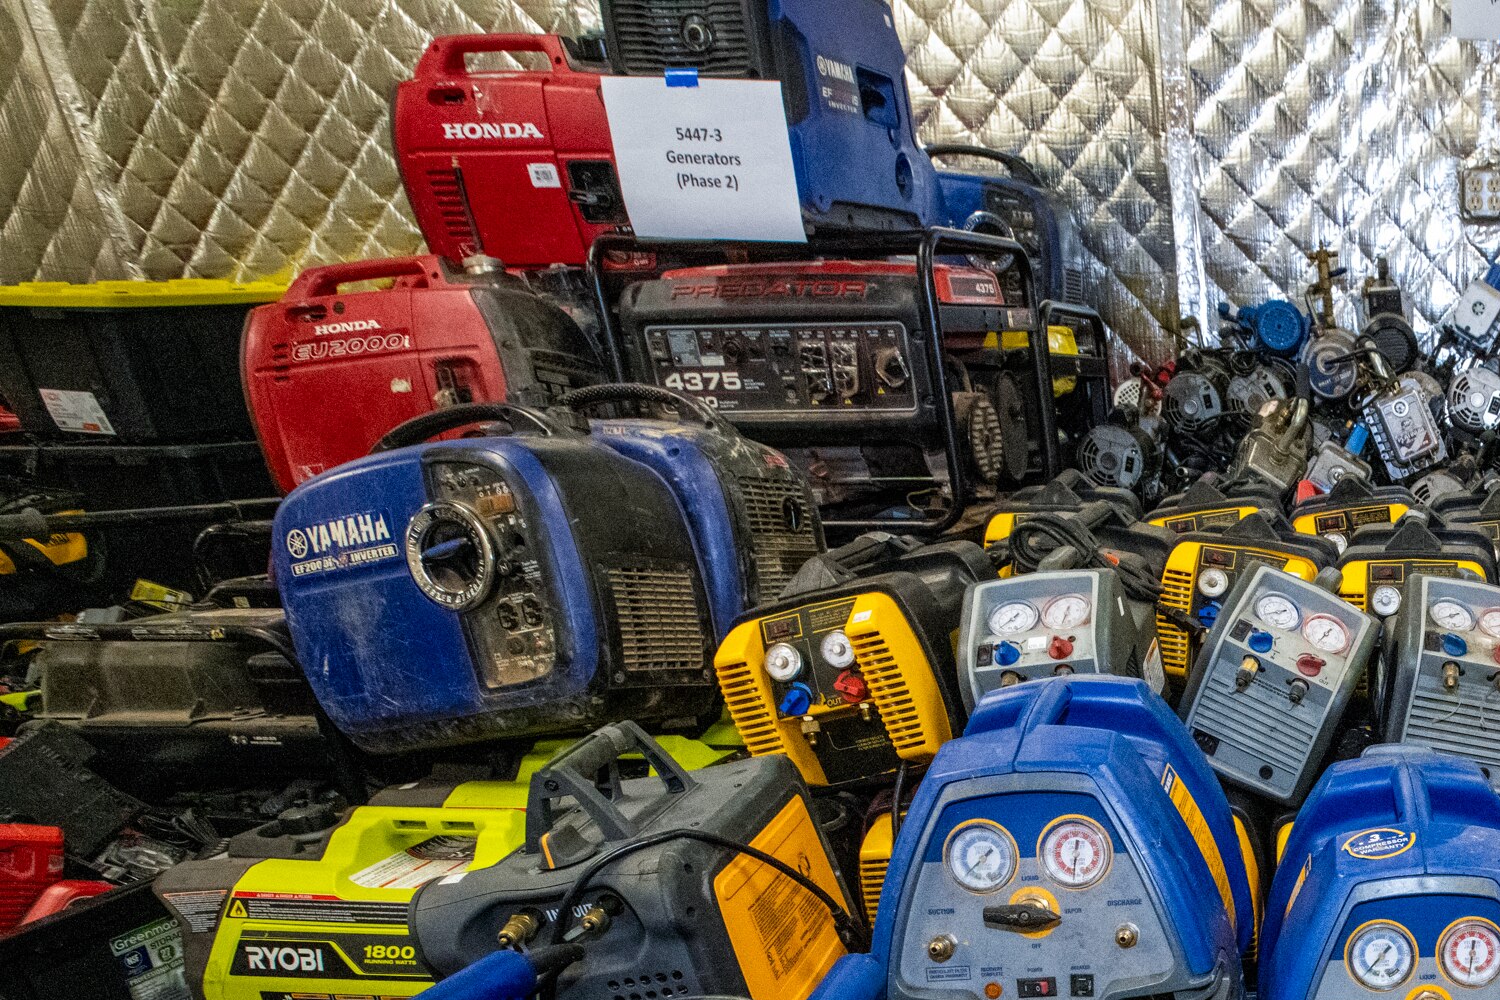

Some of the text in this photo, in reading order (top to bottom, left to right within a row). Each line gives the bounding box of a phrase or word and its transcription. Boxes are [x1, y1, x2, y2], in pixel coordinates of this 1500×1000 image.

[442, 122, 544, 139] HONDA
[676, 127, 723, 142] 5447-3
[666, 150, 742, 167] Generators
[677, 173, 740, 191] (Phase 2)
[671, 281, 867, 299] PREDATOR
[975, 284, 995, 294] 4375
[314, 319, 381, 336] HONDA
[292, 333, 411, 361] EU2000i
[665, 371, 742, 391] 4375
[306, 512, 391, 553] YAMAHA
[350, 545, 396, 563] INVERTER
[827, 698, 842, 707] OUT
[1354, 837, 1409, 852] COMPRESSOR
[572, 903, 593, 918] OUT
[1107, 898, 1143, 907] DISCHARGE
[927, 908, 955, 916] SUCTION
[126, 952, 140, 966] NSF
[245, 946, 324, 972] RYOBI
[363, 945, 415, 960] 1800
[364, 958, 394, 966] RUNNING
